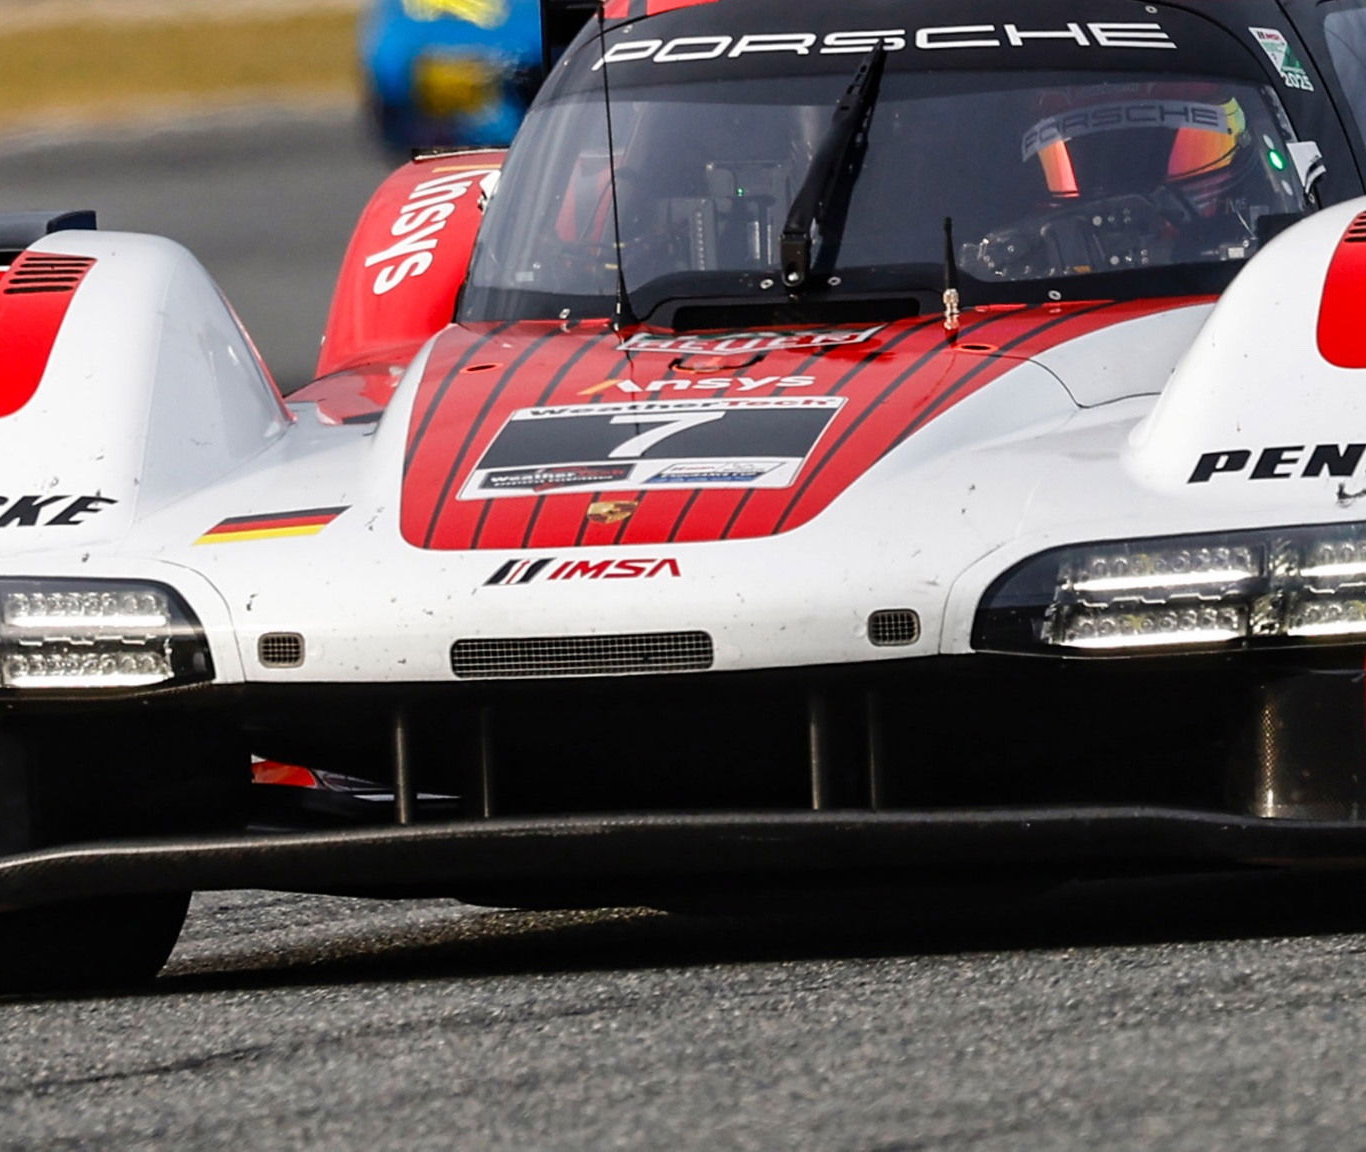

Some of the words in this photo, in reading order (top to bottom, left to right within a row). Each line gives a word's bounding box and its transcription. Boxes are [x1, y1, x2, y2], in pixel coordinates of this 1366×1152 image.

[591, 22, 1177, 71] PORSCHE
[1280, 70, 1314, 92] 2025
[1023, 104, 1220, 152] PORSCHE
[577, 374, 816, 396] Ansys
[530, 398, 828, 416] WeatherTech
[607, 410, 727, 459] 7
[547, 558, 682, 580] IMSA
